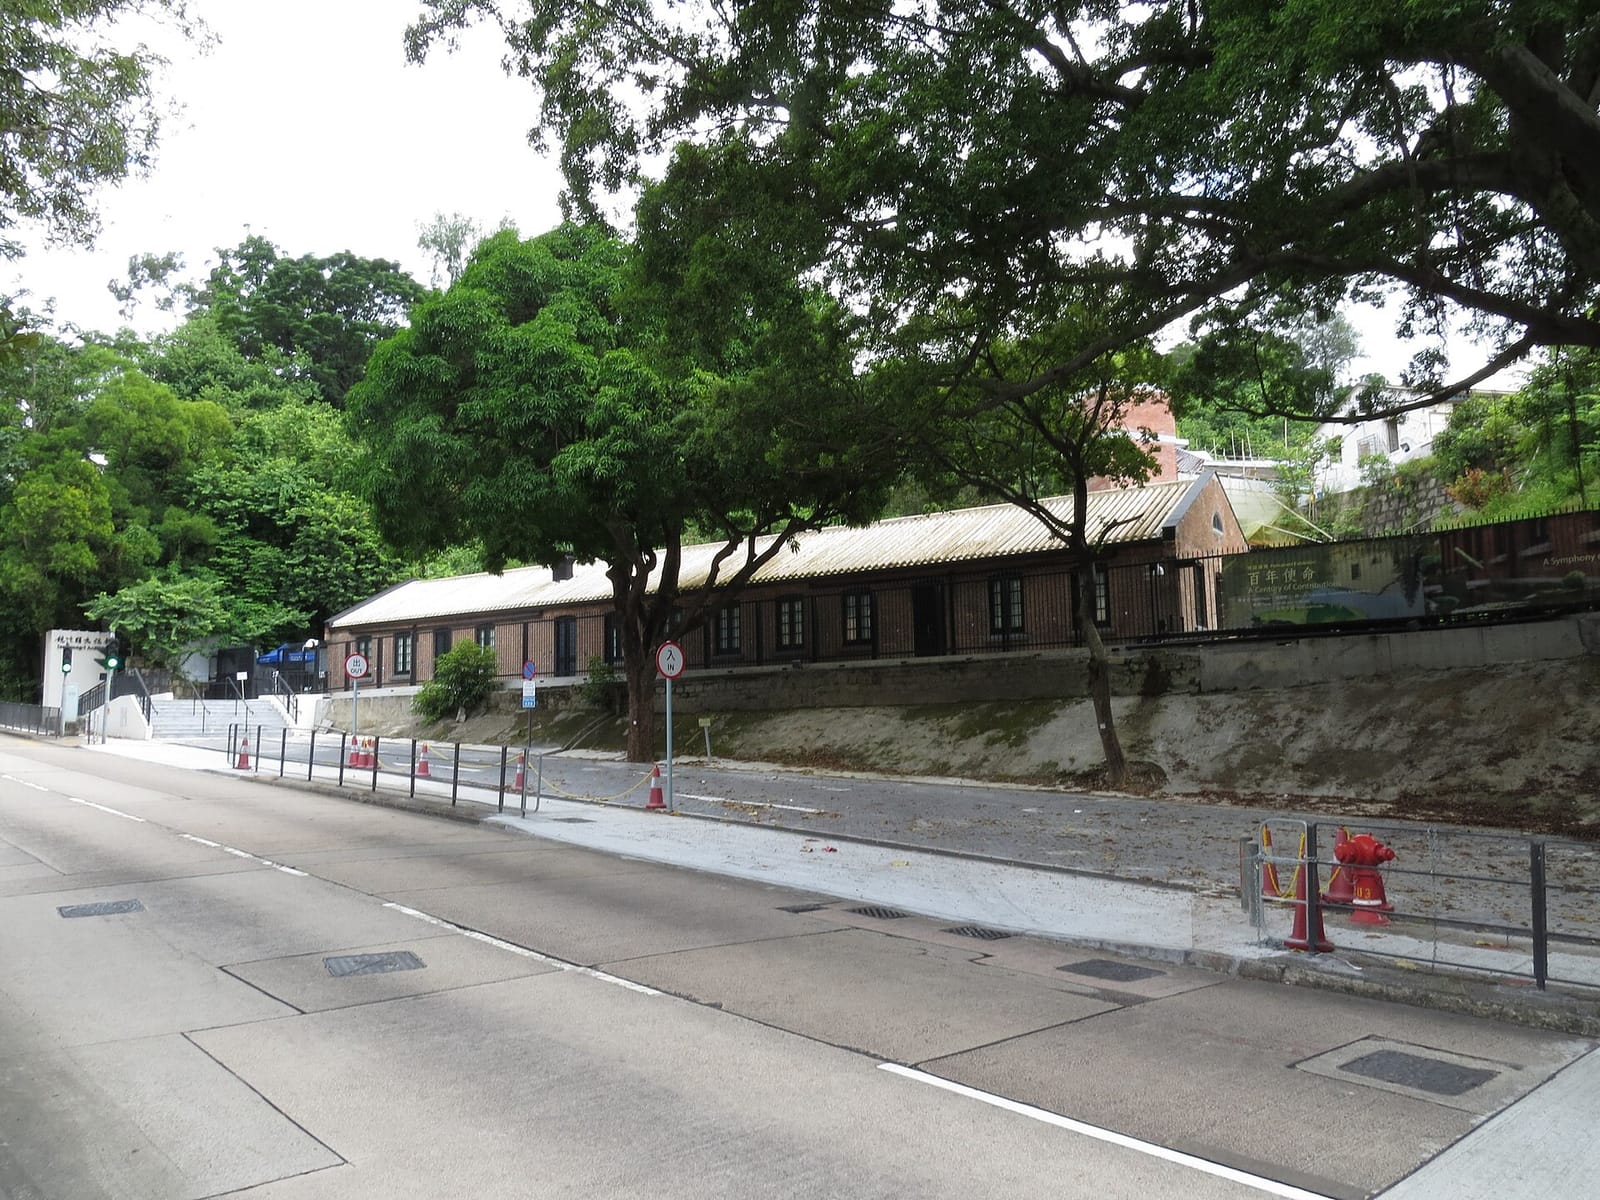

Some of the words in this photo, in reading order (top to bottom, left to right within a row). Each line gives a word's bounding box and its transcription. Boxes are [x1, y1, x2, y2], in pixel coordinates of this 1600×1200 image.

[1550, 553, 1596, 567] Symphony
[1247, 565, 1314, 586] 百年使命
[1254, 584, 1282, 593] Century
[666, 650, 675, 662] 入
[353, 658, 361, 667] 出
